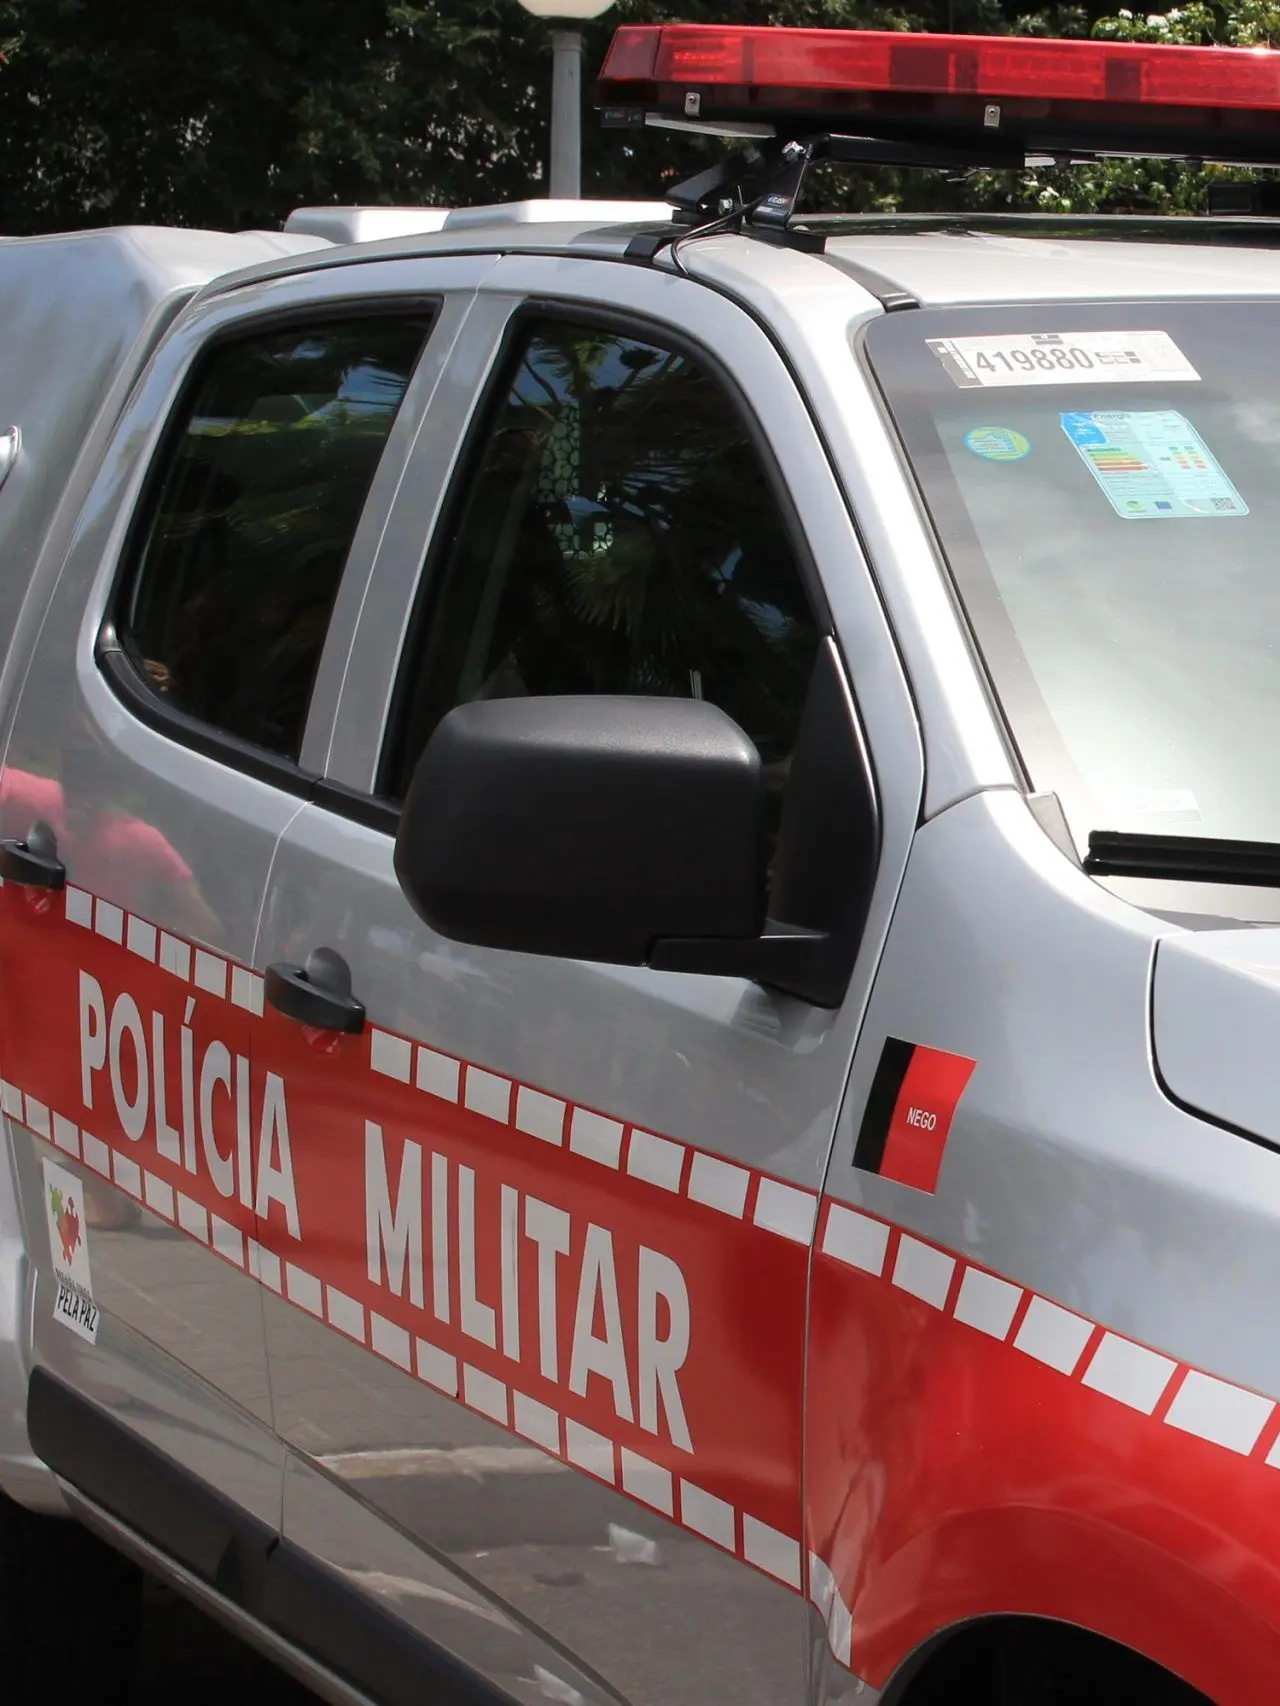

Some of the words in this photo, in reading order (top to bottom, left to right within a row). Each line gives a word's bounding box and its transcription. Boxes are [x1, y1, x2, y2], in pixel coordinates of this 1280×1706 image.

[976, 348, 1094, 373] 419880
[906, 1107, 937, 1131] NEGO
[79, 969, 301, 1241] POLÍCIA
[365, 1119, 695, 1455] MILITAR
[57, 1284, 79, 1320] PELA
[79, 1299, 97, 1332] PAZ
